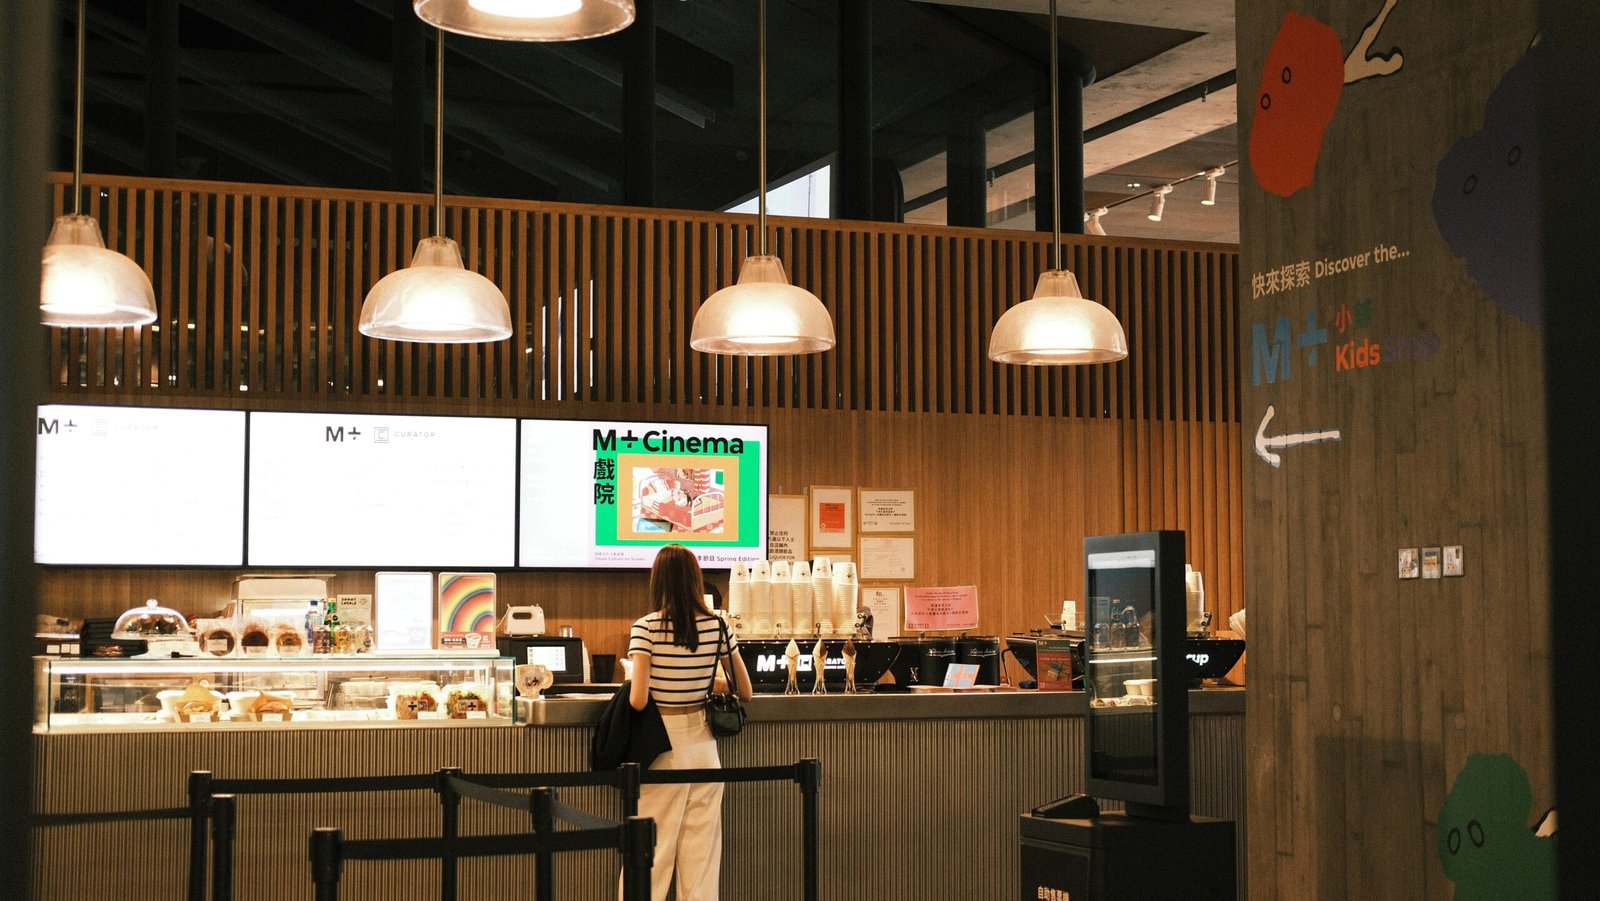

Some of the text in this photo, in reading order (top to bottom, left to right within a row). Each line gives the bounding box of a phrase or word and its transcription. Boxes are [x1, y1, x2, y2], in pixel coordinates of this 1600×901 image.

[1251, 260, 1311, 299] 快來探索
[1314, 250, 1371, 279] Discover
[1251, 307, 1328, 386] M+
[1335, 338, 1381, 373] Kids
[37, 417, 77, 435] M+
[325, 425, 361, 442] M+
[593, 429, 744, 454] M+ Cinema
[593, 458, 615, 505] 戲院
[756, 654, 789, 672] M+
